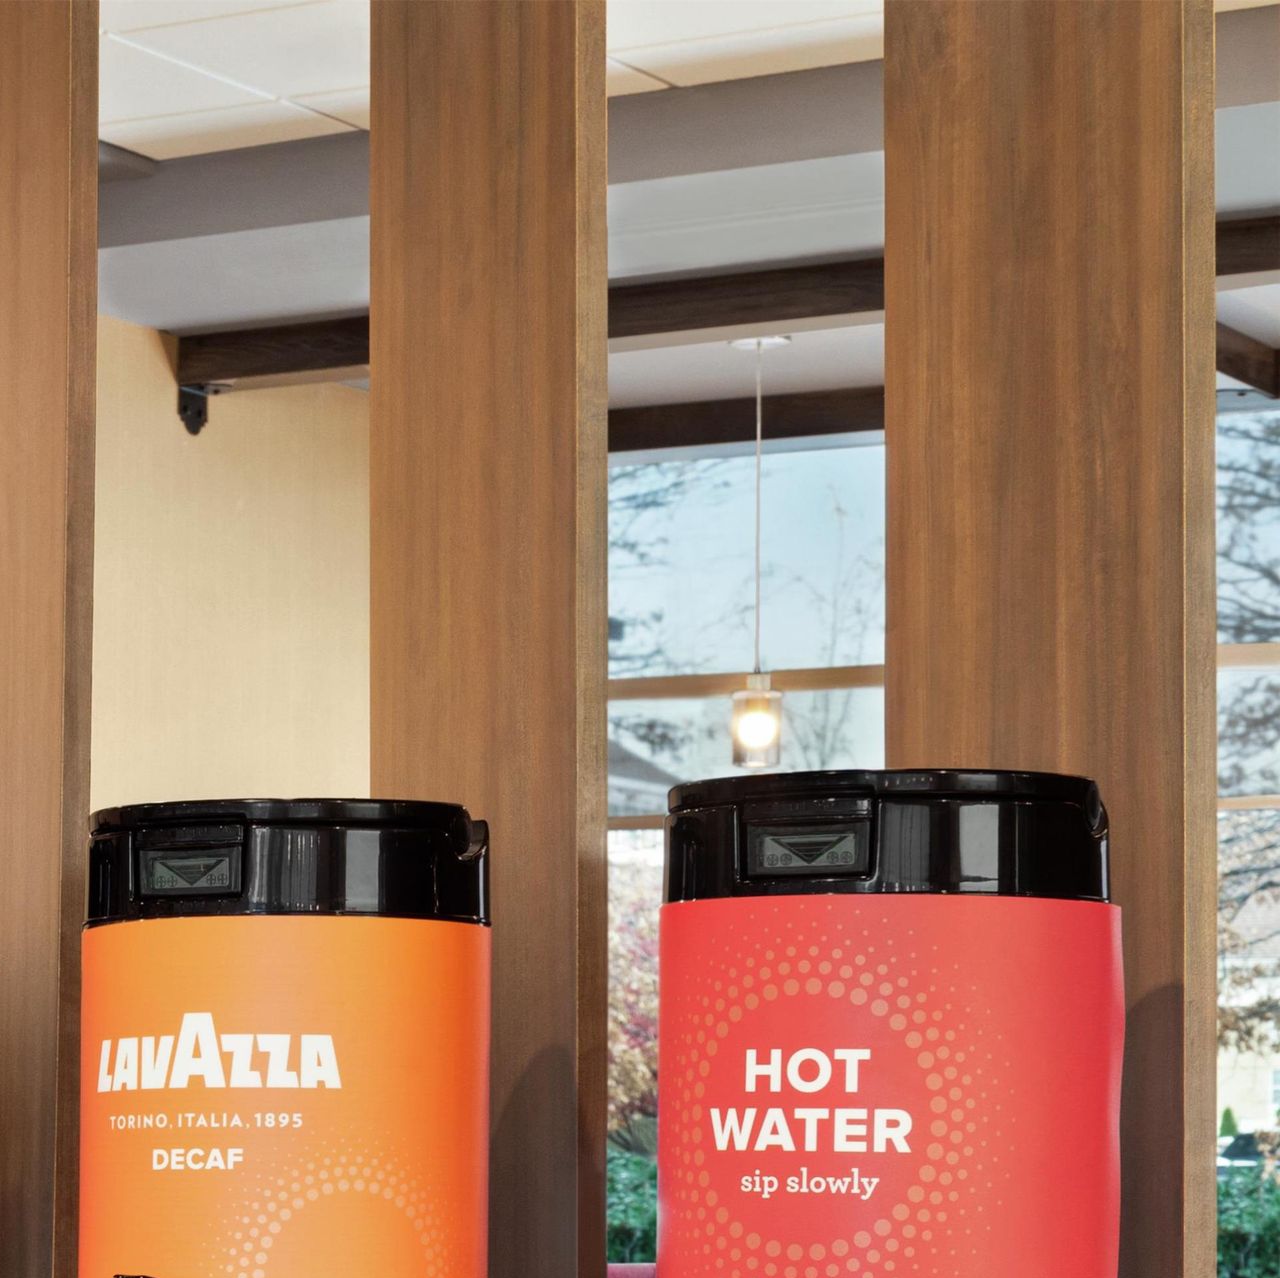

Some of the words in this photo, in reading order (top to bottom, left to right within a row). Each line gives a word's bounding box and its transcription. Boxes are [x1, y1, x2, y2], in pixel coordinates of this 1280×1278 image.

[97, 1012, 342, 1092] LAVAZZA
[744, 1048, 871, 1094] HOT
[254, 1112, 303, 1128] 1895
[710, 1108, 913, 1154] WATER
[152, 1148, 244, 1170] DECAF
[740, 1169, 779, 1199] sip
[786, 1167, 880, 1201] slowly
